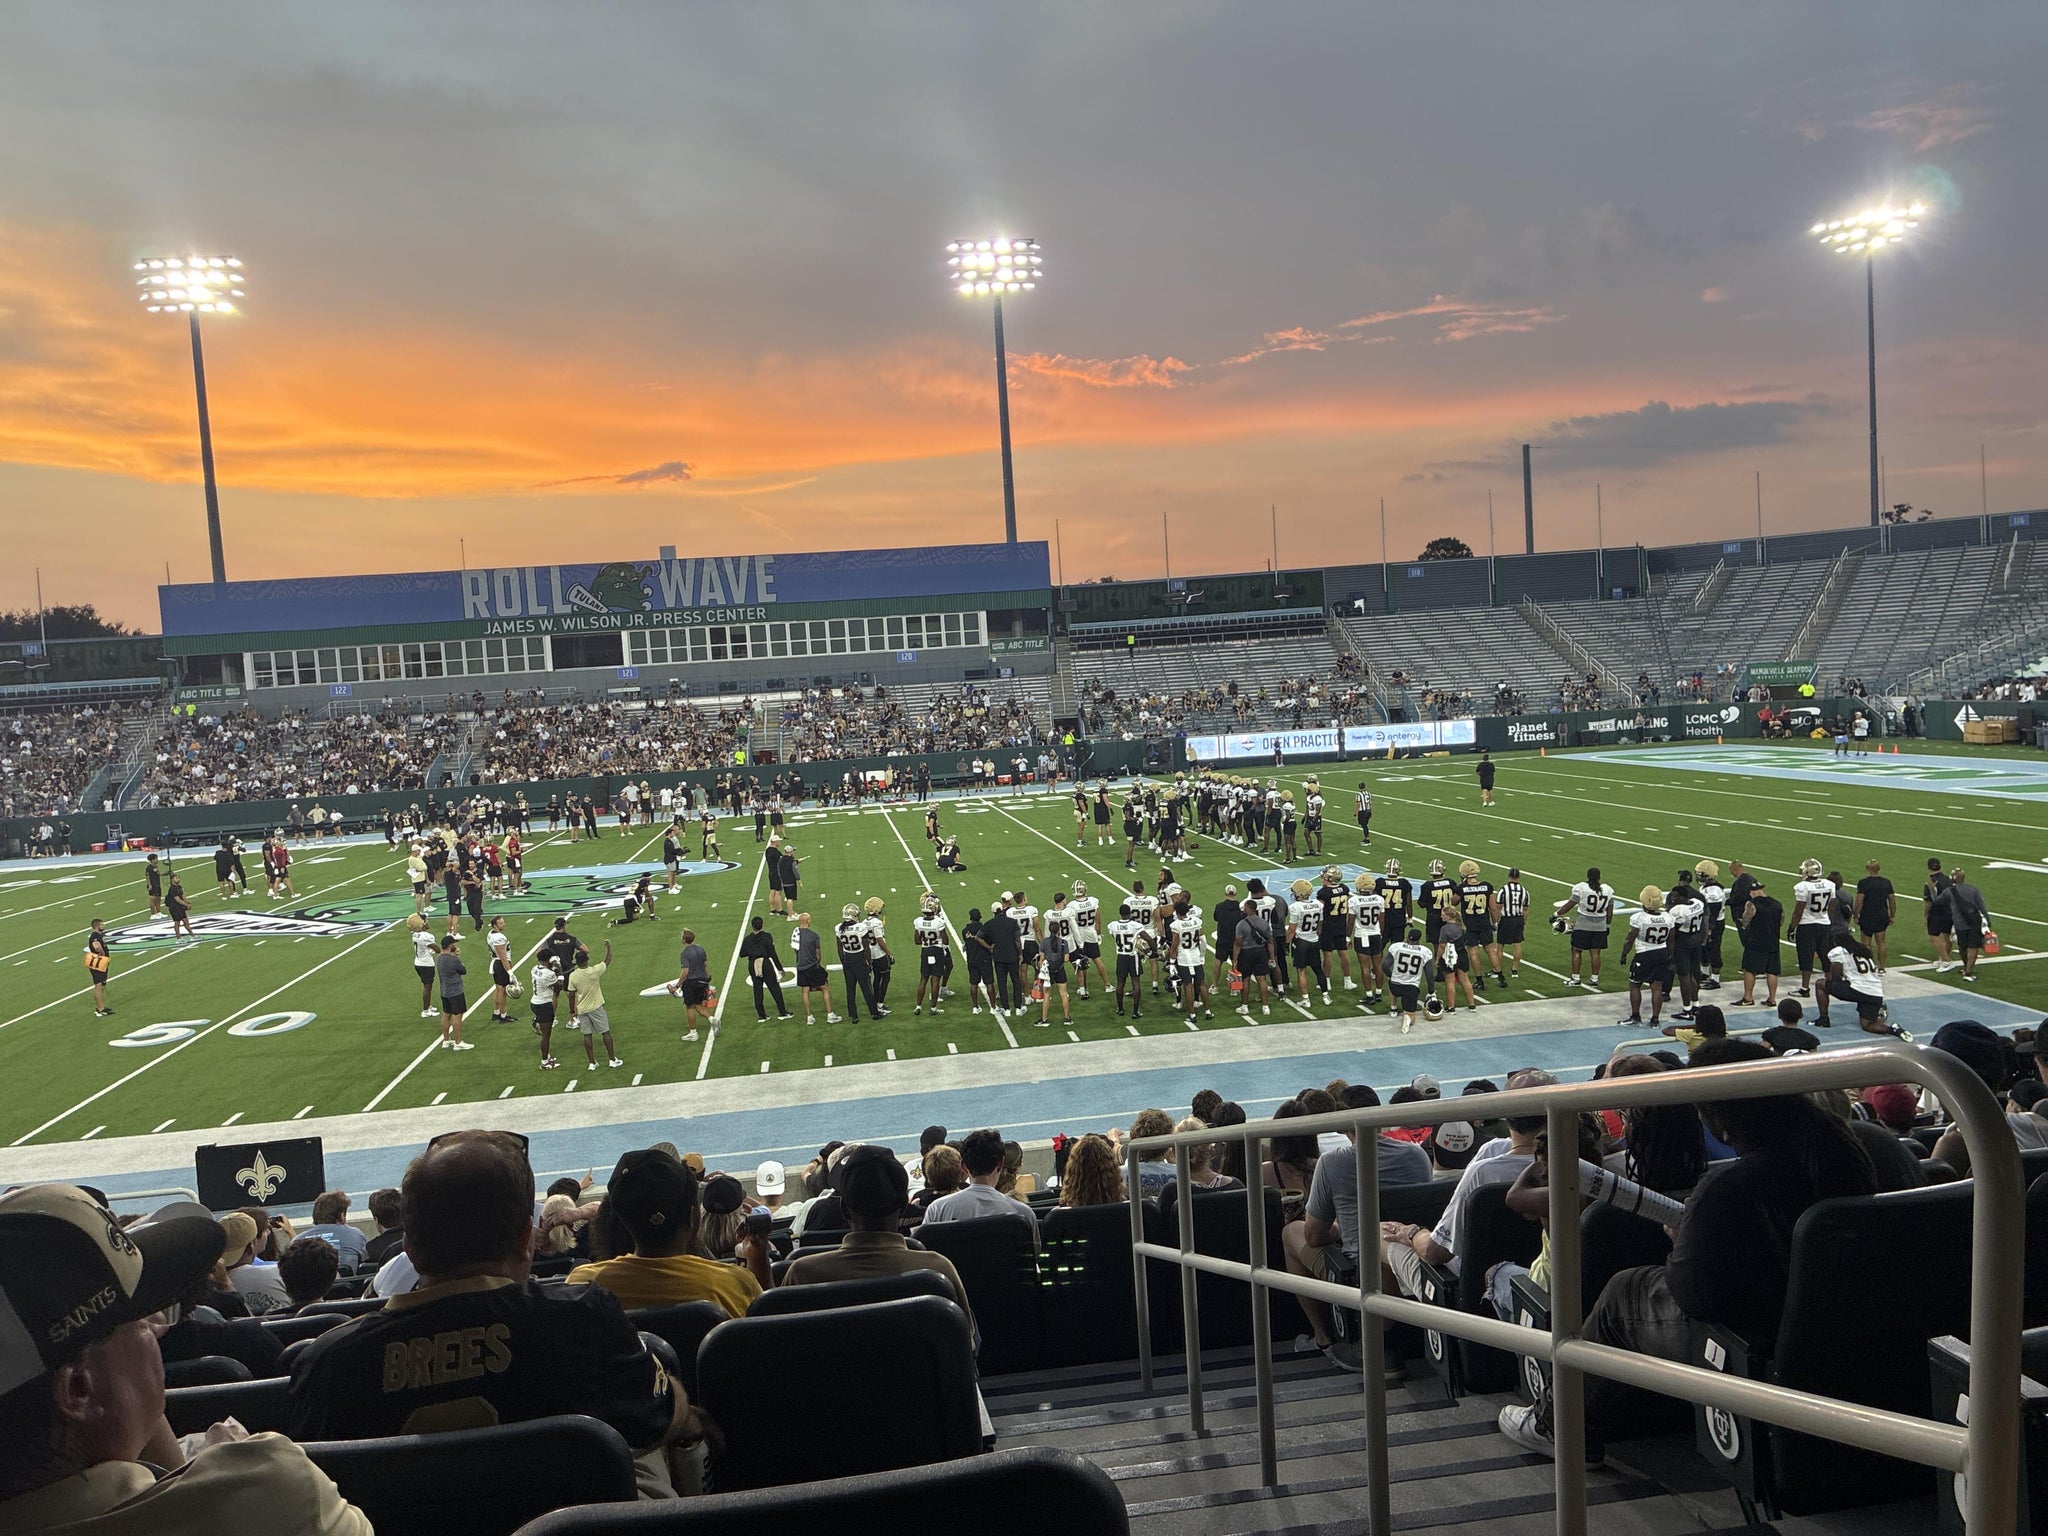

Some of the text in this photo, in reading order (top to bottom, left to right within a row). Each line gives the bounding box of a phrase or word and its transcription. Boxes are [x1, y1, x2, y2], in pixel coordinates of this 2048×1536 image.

[461, 555, 778, 619] ROLL WAVE
[574, 589, 605, 611] TULANE
[484, 607, 767, 635] JAMES W. WILSON JR. PRESS CENTER
[1008, 641, 1024, 650] ABC
[1025, 639, 1044, 649] TITLE
[901, 652, 912, 661] 120
[622, 669, 633, 678] 121
[180, 689, 198, 699] ABC
[200, 687, 222, 698] TITLE
[334, 686, 348, 695] 122
[1507, 721, 1548, 736] planet
[1685, 713, 1719, 725] LCMC
[1387, 731, 1422, 741] entergy
[1513, 730, 1556, 742] fitness
[1686, 724, 1723, 736] Health
[941, 845, 954, 856] 17
[1330, 894, 1349, 916] 73
[1381, 888, 1403, 909] 74
[1431, 888, 1453, 909] 70
[1464, 893, 1487, 915] 79
[1511, 891, 1521, 905] H
[1586, 894, 1608, 914] 97
[1809, 891, 1832, 913] 57
[1077, 908, 1096, 927] 55
[1131, 908, 1151, 925] 28
[1301, 912, 1321, 932] 63
[1359, 905, 1381, 926] 56
[840, 934, 862, 951] 22
[920, 930, 940, 947] 42
[1115, 933, 1134, 953] 45
[1181, 928, 1200, 950] 34
[1645, 926, 1670, 945] 62
[1397, 952, 1422, 976] 59
[108, 1010, 317, 1048] 50
[48, 1286, 117, 1343] SAINTS
[382, 1322, 512, 1393] BREES
